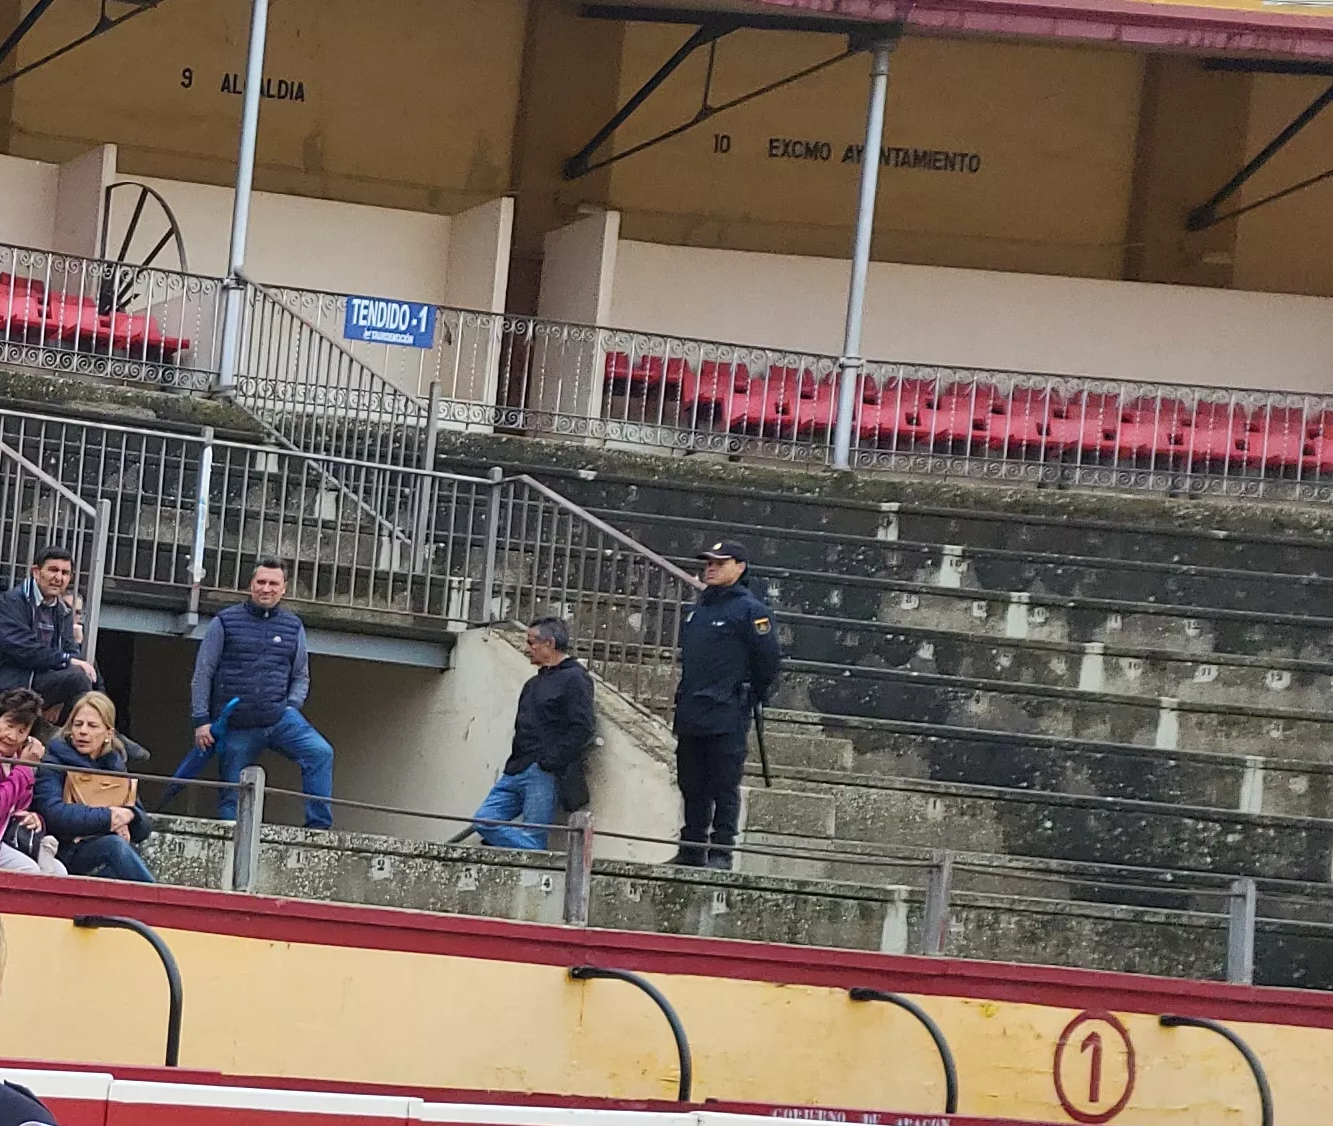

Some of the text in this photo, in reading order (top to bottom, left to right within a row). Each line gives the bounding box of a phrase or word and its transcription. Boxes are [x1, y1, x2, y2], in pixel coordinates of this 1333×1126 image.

[180, 67, 305, 102] 9 ALLDIA
[713, 133, 981, 173] 10 EXCMO AYNTAMIENTO
[351, 298, 411, 331] TENDIDO
[1080, 1031, 1103, 1104] 1
